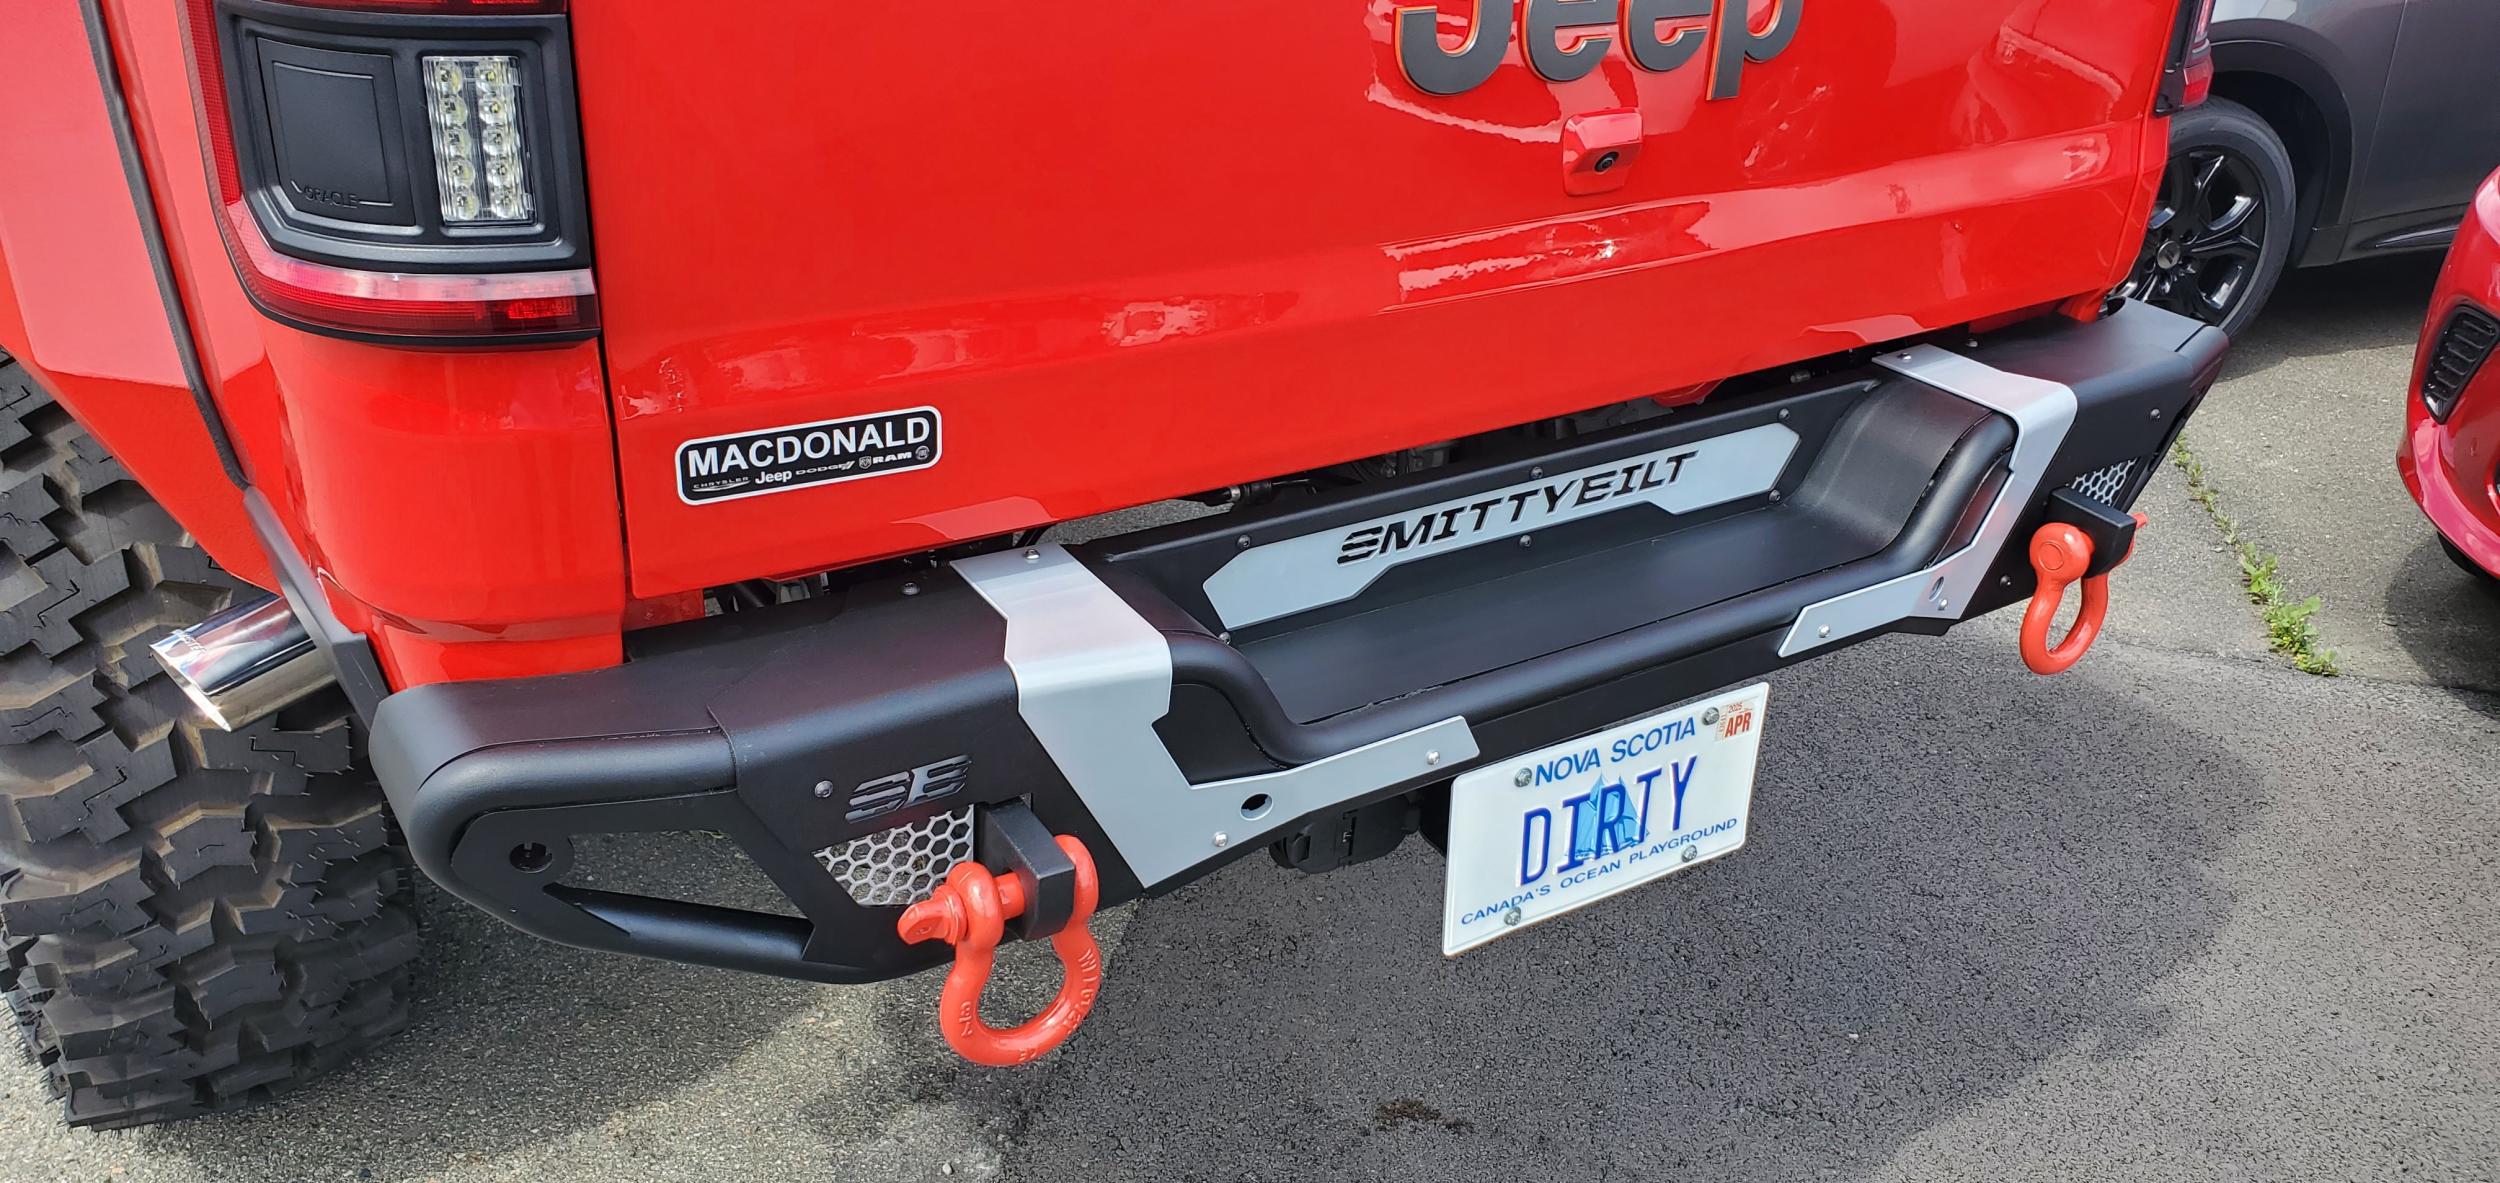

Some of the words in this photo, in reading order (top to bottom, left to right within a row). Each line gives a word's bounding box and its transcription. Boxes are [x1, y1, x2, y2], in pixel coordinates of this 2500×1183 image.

[1394, 0, 1801, 100] Jeep
[687, 416, 930, 478] MACDONALD
[693, 476, 749, 489] CHRYSLER
[755, 470, 793, 484] Jeep
[872, 451, 912, 464] RAM
[1534, 748, 1601, 787] NOVA
[1610, 716, 1696, 763] SCOTIA
[1724, 711, 1752, 738] APR
[1519, 754, 1697, 886] DIRTY
[1460, 884, 1551, 926] CANADA'S
[1560, 859, 1621, 889] OCEAN
[1628, 818, 1738, 865] PLAYGROUND
